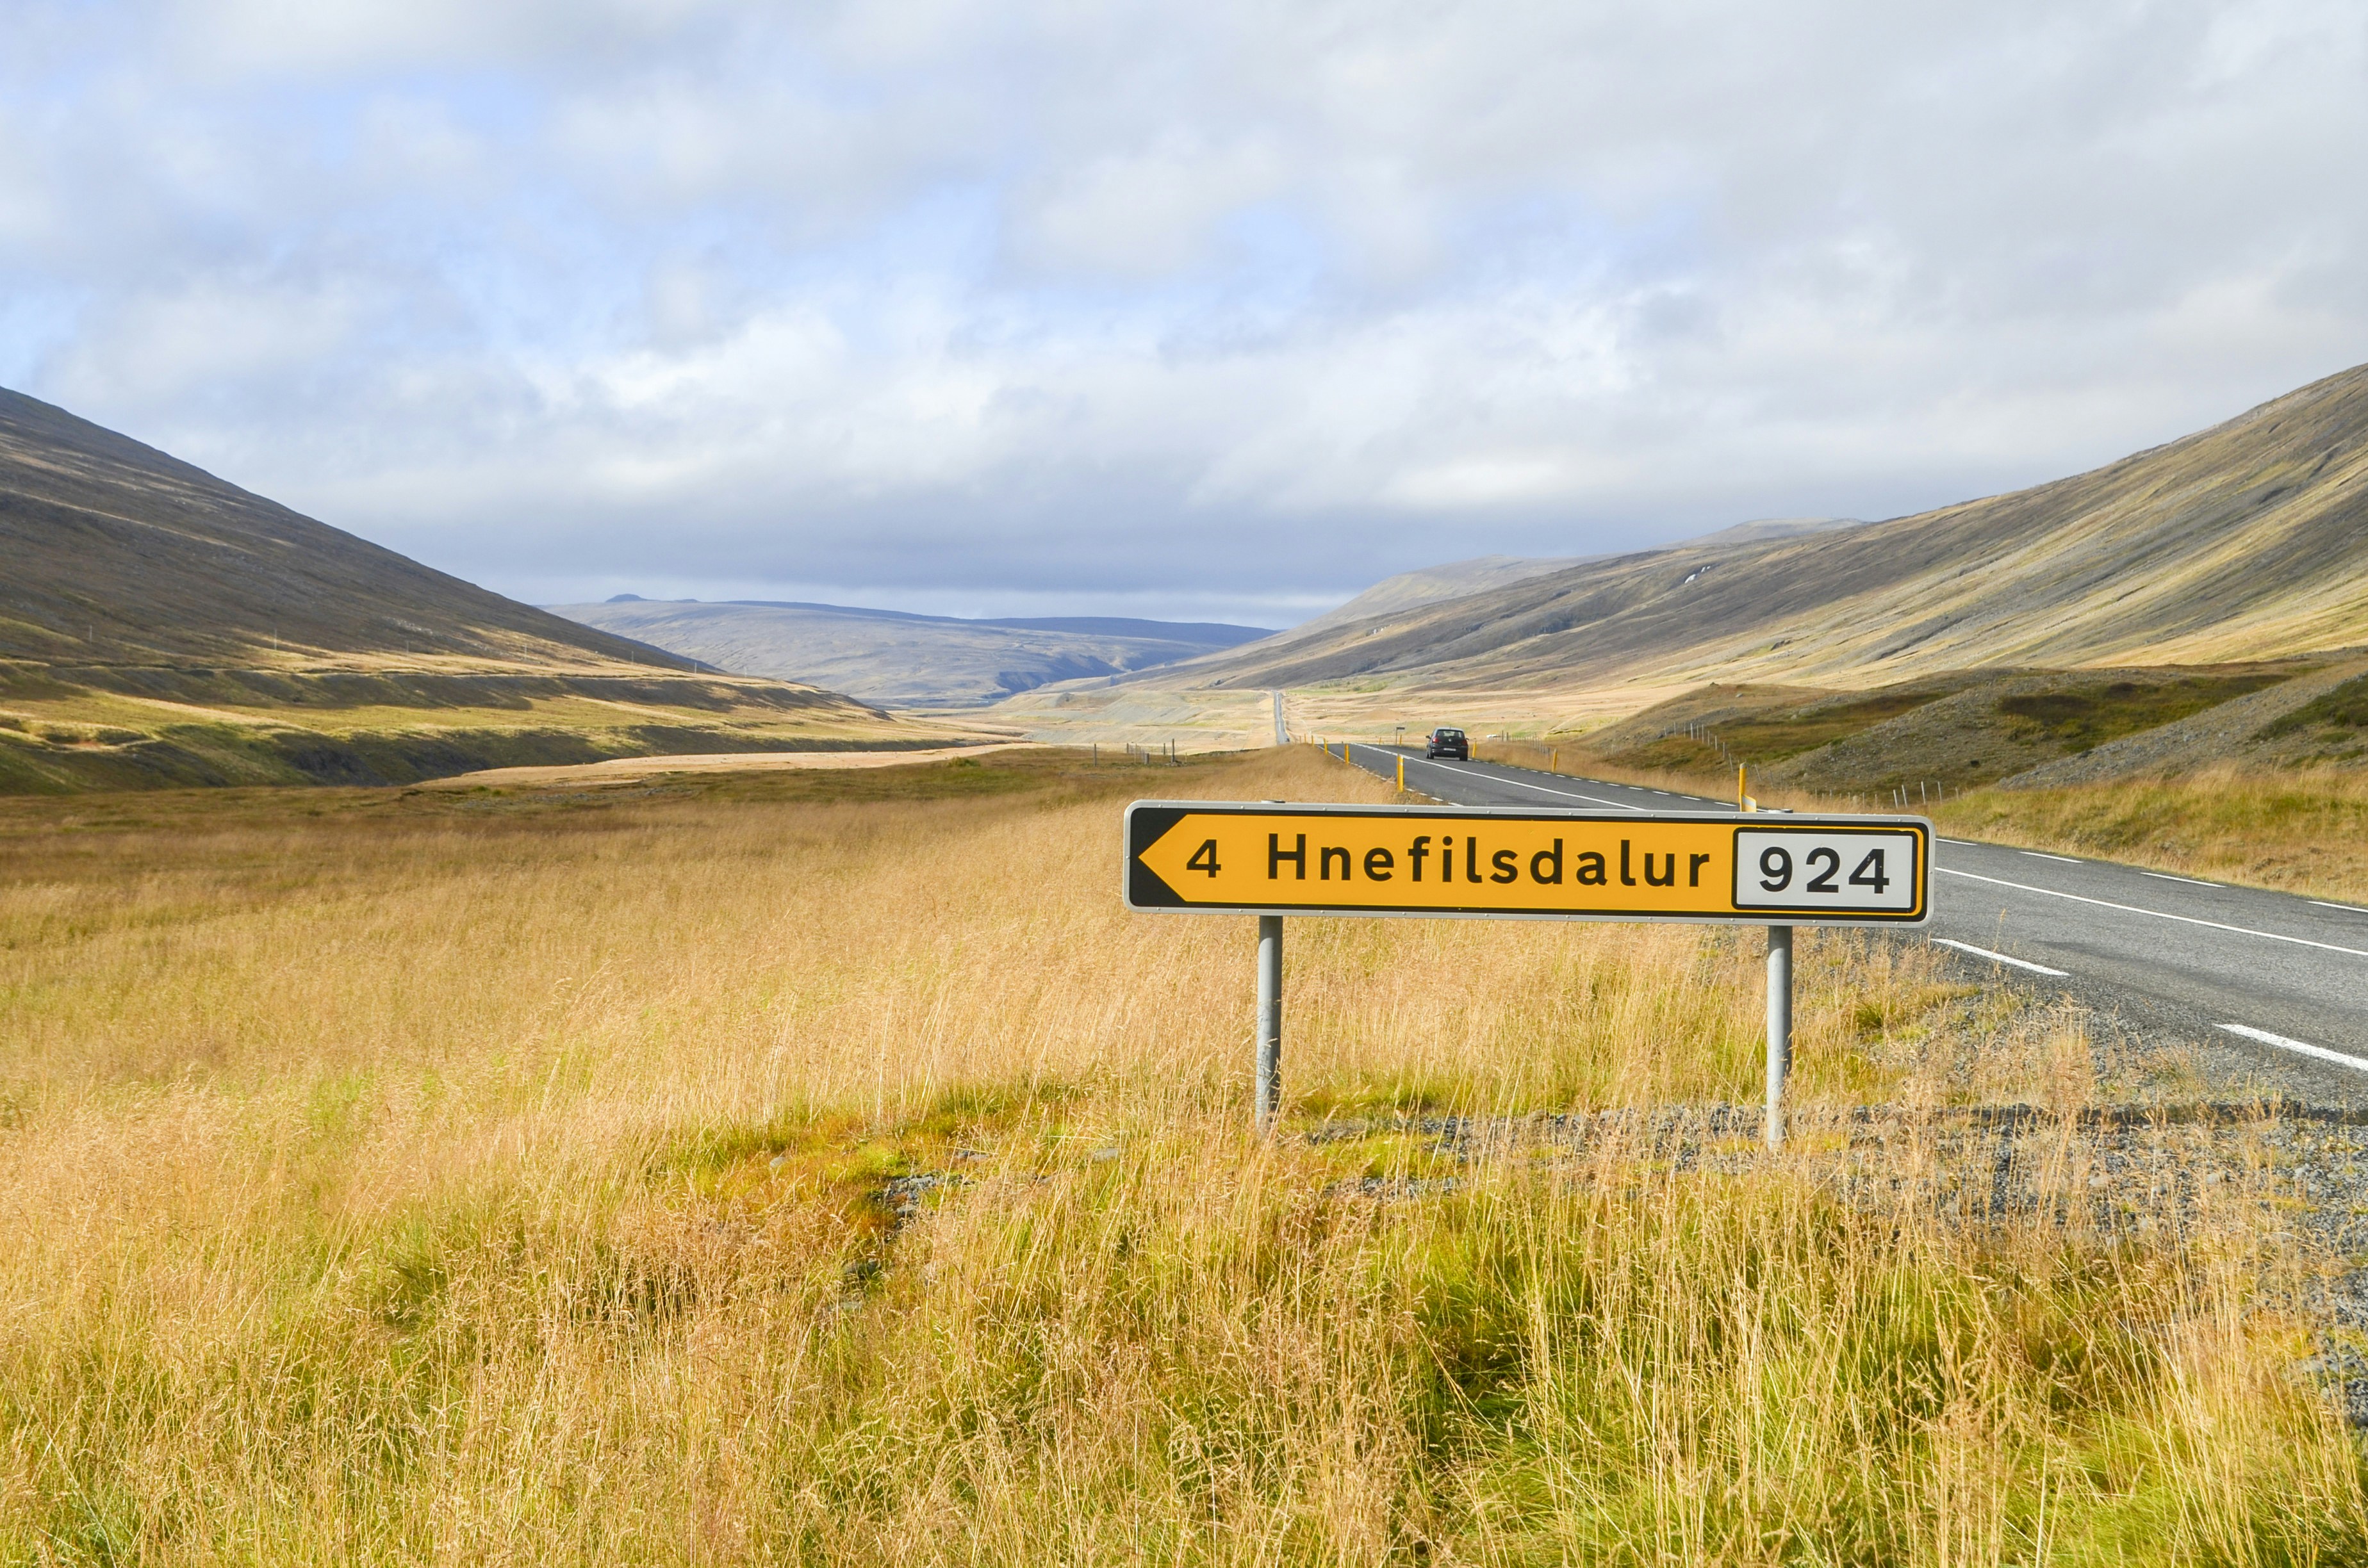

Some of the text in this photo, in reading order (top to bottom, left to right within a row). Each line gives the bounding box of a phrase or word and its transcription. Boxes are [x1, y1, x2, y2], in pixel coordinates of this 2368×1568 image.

[1187, 833, 1890, 894] 4 Hnefilsdalur 924
